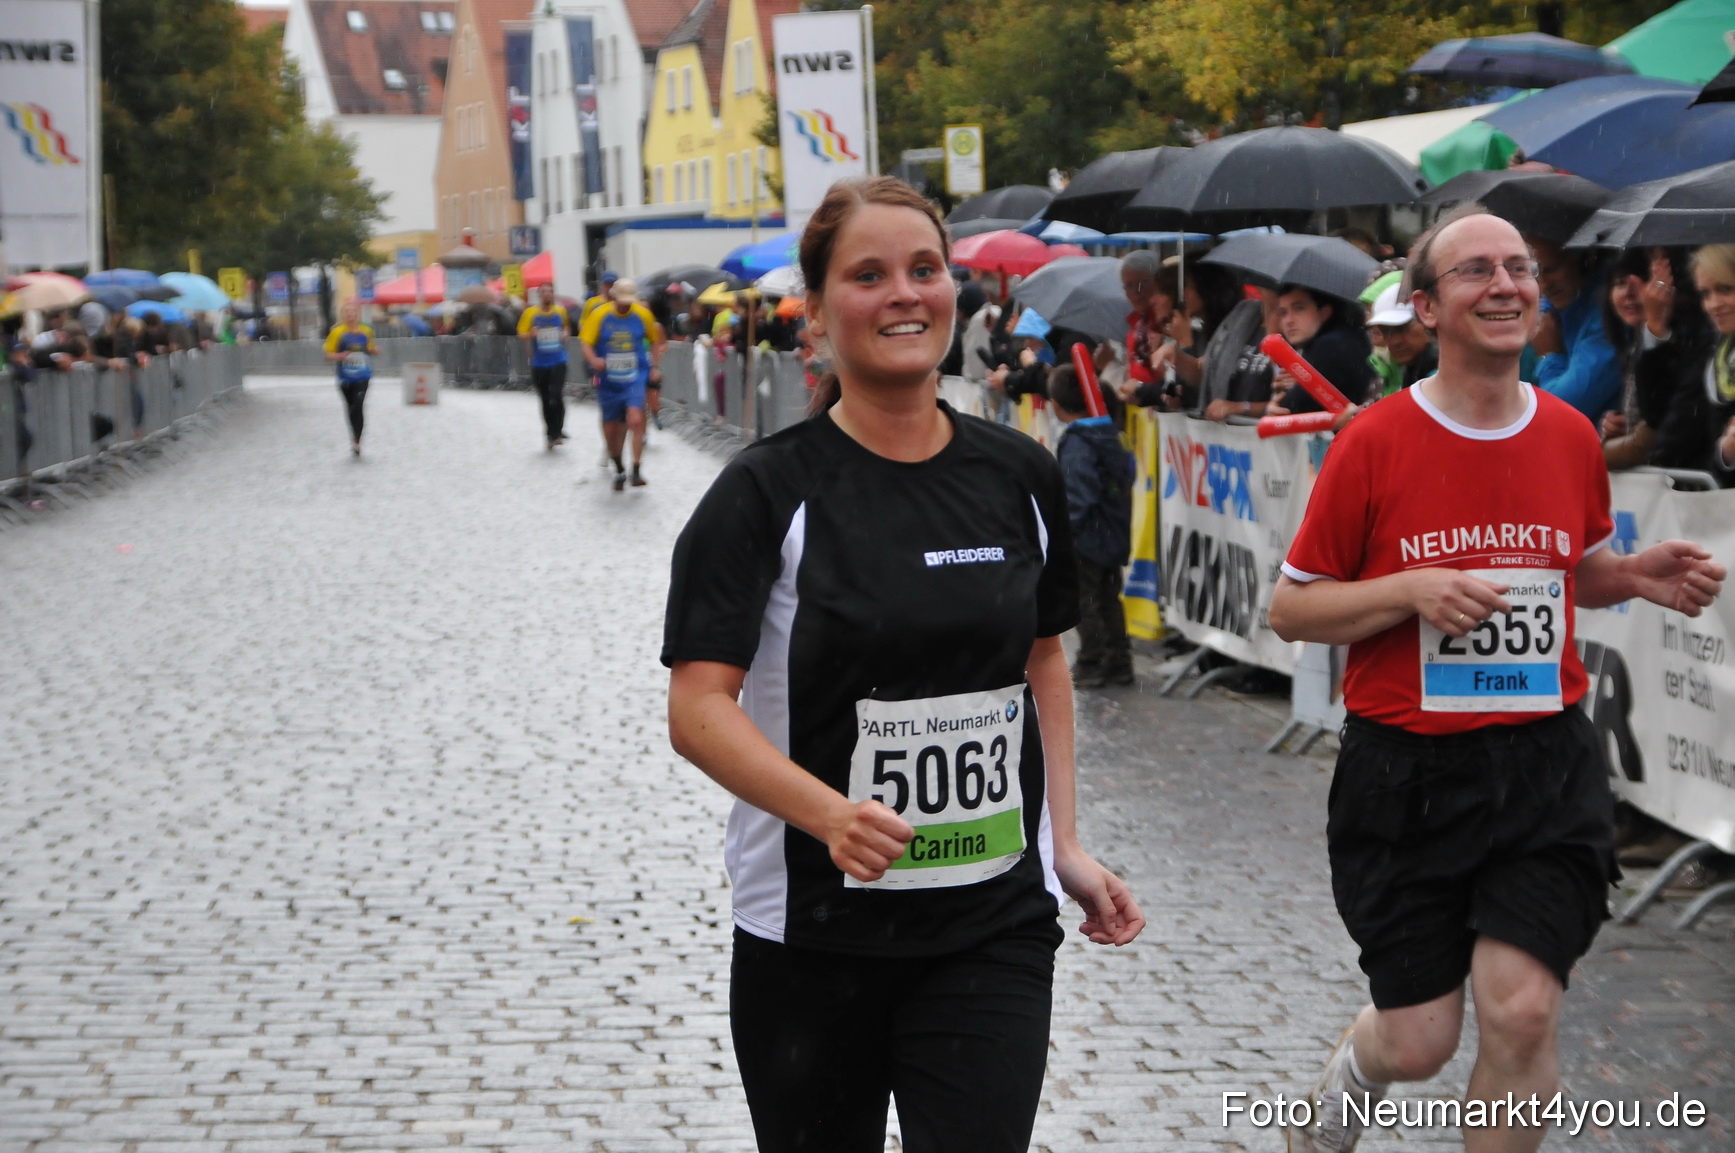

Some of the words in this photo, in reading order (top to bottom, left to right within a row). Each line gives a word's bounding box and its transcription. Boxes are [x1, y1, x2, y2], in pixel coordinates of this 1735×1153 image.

[1400, 523, 1551, 562] NEUMARKT
[938, 547, 1005, 565] PFLEIDERER
[1490, 557, 1523, 565] STARKE
[1525, 557, 1551, 566] STADT
[1500, 584, 1545, 596] markt
[1474, 671, 1529, 691] Frank
[926, 709, 1001, 735] Neumarkt
[871, 734, 1008, 815] 5063
[909, 831, 986, 862] Carina
